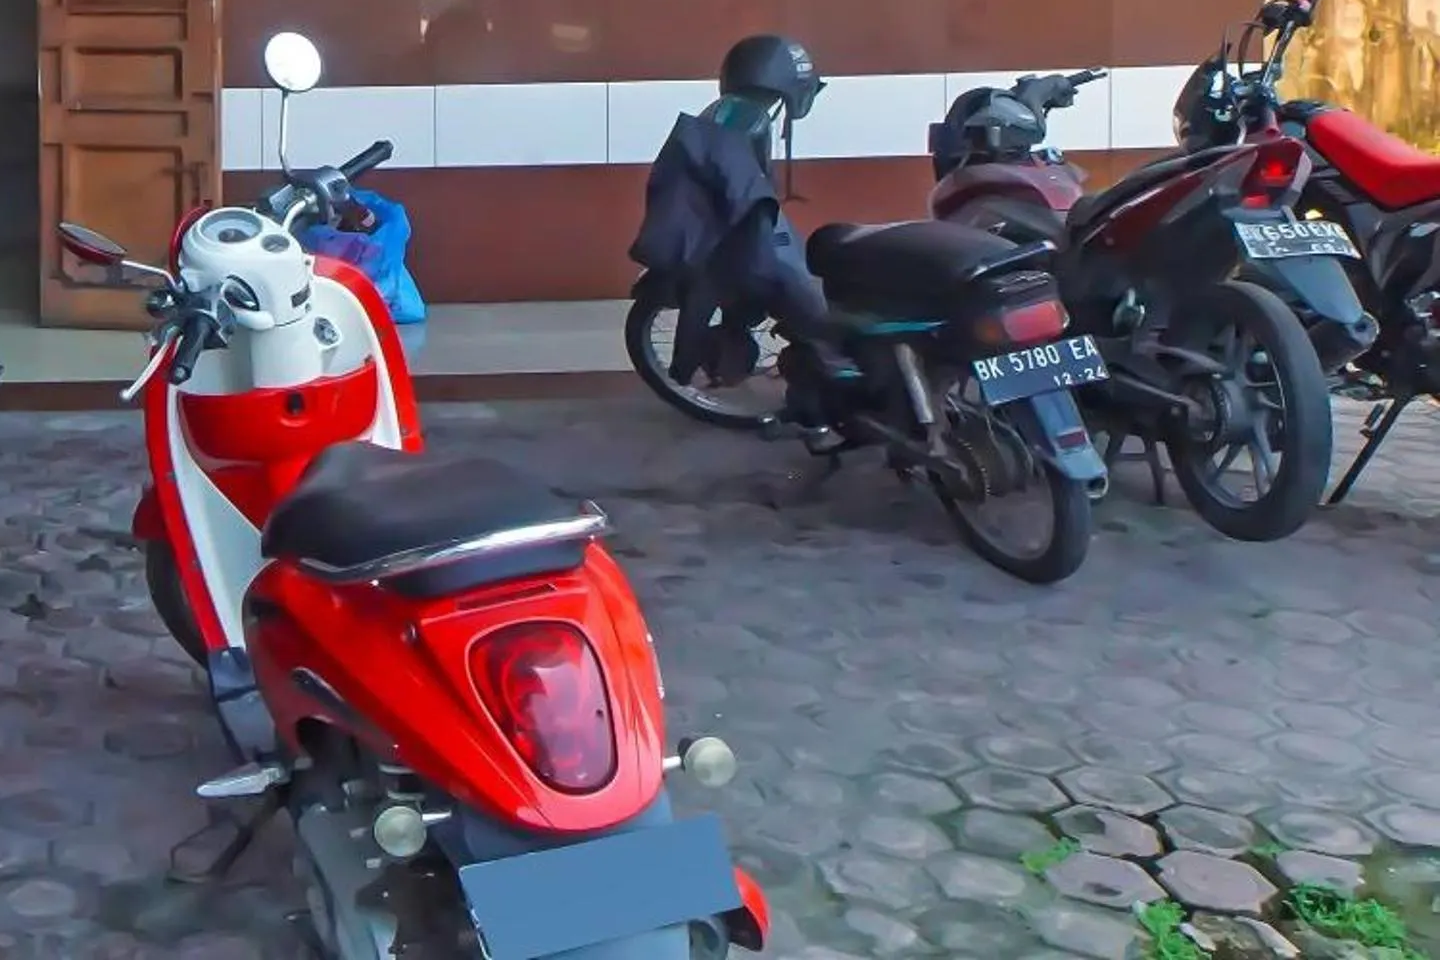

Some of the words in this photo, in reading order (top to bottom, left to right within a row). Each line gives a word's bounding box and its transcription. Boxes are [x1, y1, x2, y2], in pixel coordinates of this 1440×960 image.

[973, 357, 1004, 380] BK
[1008, 345, 1061, 372] 5780
[1068, 337, 1099, 360] EA
